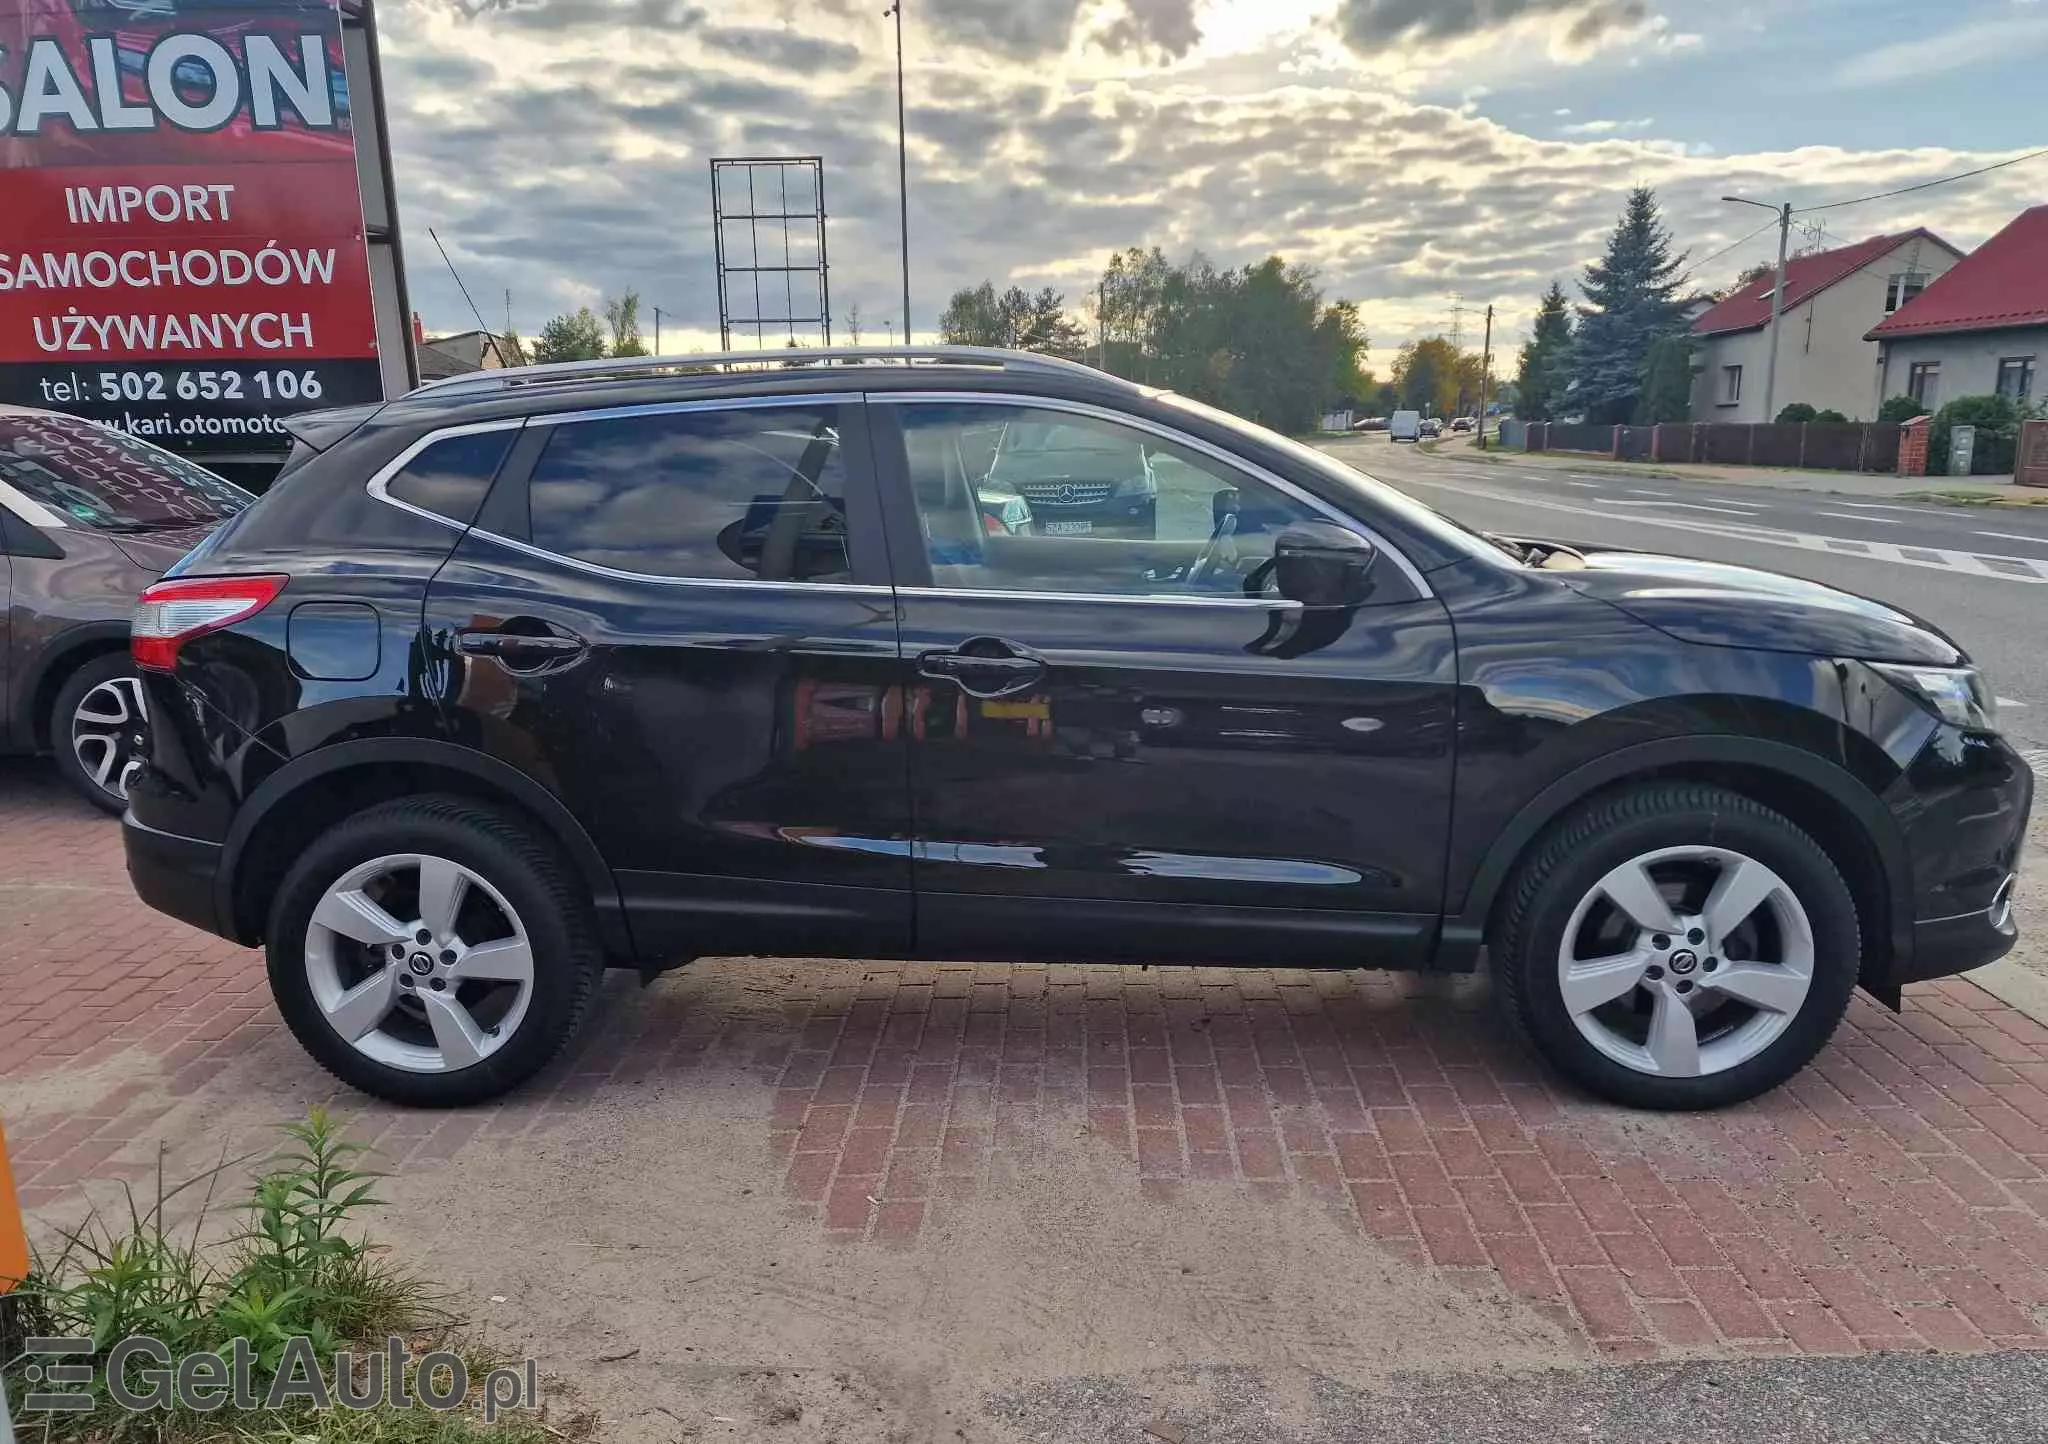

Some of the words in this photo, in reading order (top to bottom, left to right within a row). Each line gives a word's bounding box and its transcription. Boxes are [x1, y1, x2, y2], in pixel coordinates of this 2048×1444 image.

[0, 33, 334, 132] ALON
[65, 184, 235, 224] IMPORT
[33, 306, 314, 352] UŻYWANYCH
[40, 371, 90, 402] tel:
[100, 371, 167, 401] 502
[176, 370, 245, 400] 652
[253, 370, 322, 400] 106
